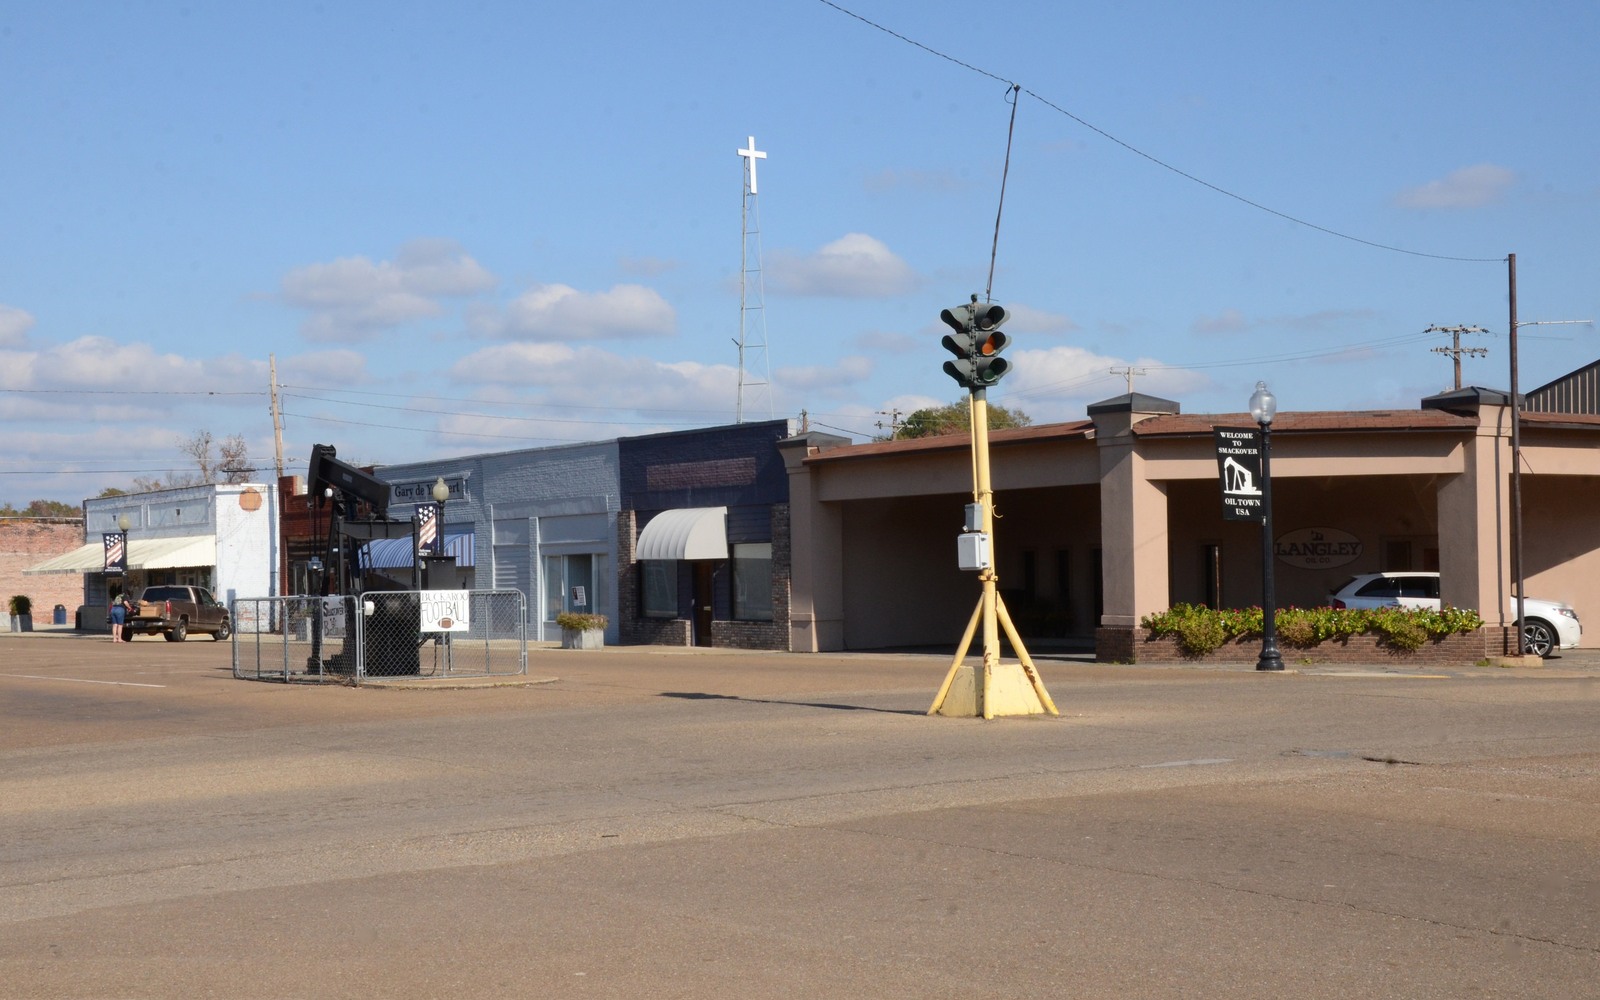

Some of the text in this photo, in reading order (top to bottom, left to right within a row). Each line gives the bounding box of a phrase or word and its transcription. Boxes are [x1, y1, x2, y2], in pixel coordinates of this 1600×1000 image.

[1218, 447, 1258, 455] SMACKOVER
[394, 482, 460, 499] Gary de Yert
[1225, 498, 1261, 507] OIL TOWN
[1235, 508, 1250, 516] USA
[1274, 542, 1361, 556] LANGLEY
[421, 592, 469, 601] BUCKAROO
[420, 600, 469, 627] FOOTBALL
